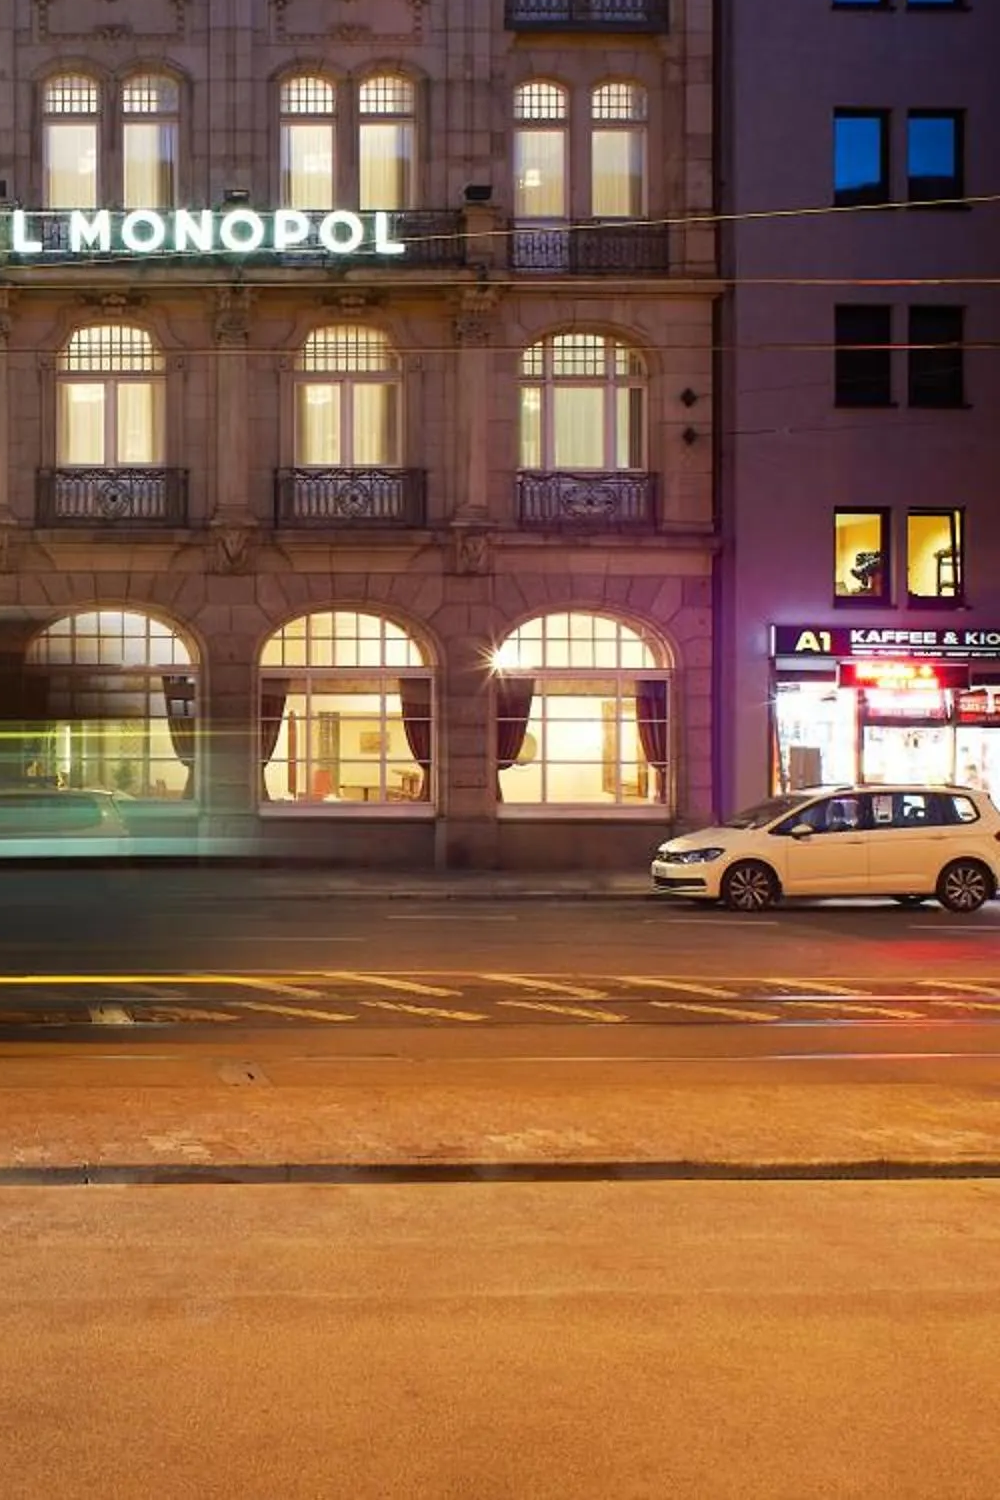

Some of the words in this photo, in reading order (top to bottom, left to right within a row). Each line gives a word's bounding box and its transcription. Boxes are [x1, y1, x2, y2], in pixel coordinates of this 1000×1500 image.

[70, 208, 407, 254] MONOPOL
[795, 631, 832, 652] A1
[850, 629, 937, 644] KAFFEE
[943, 631, 959, 645] &
